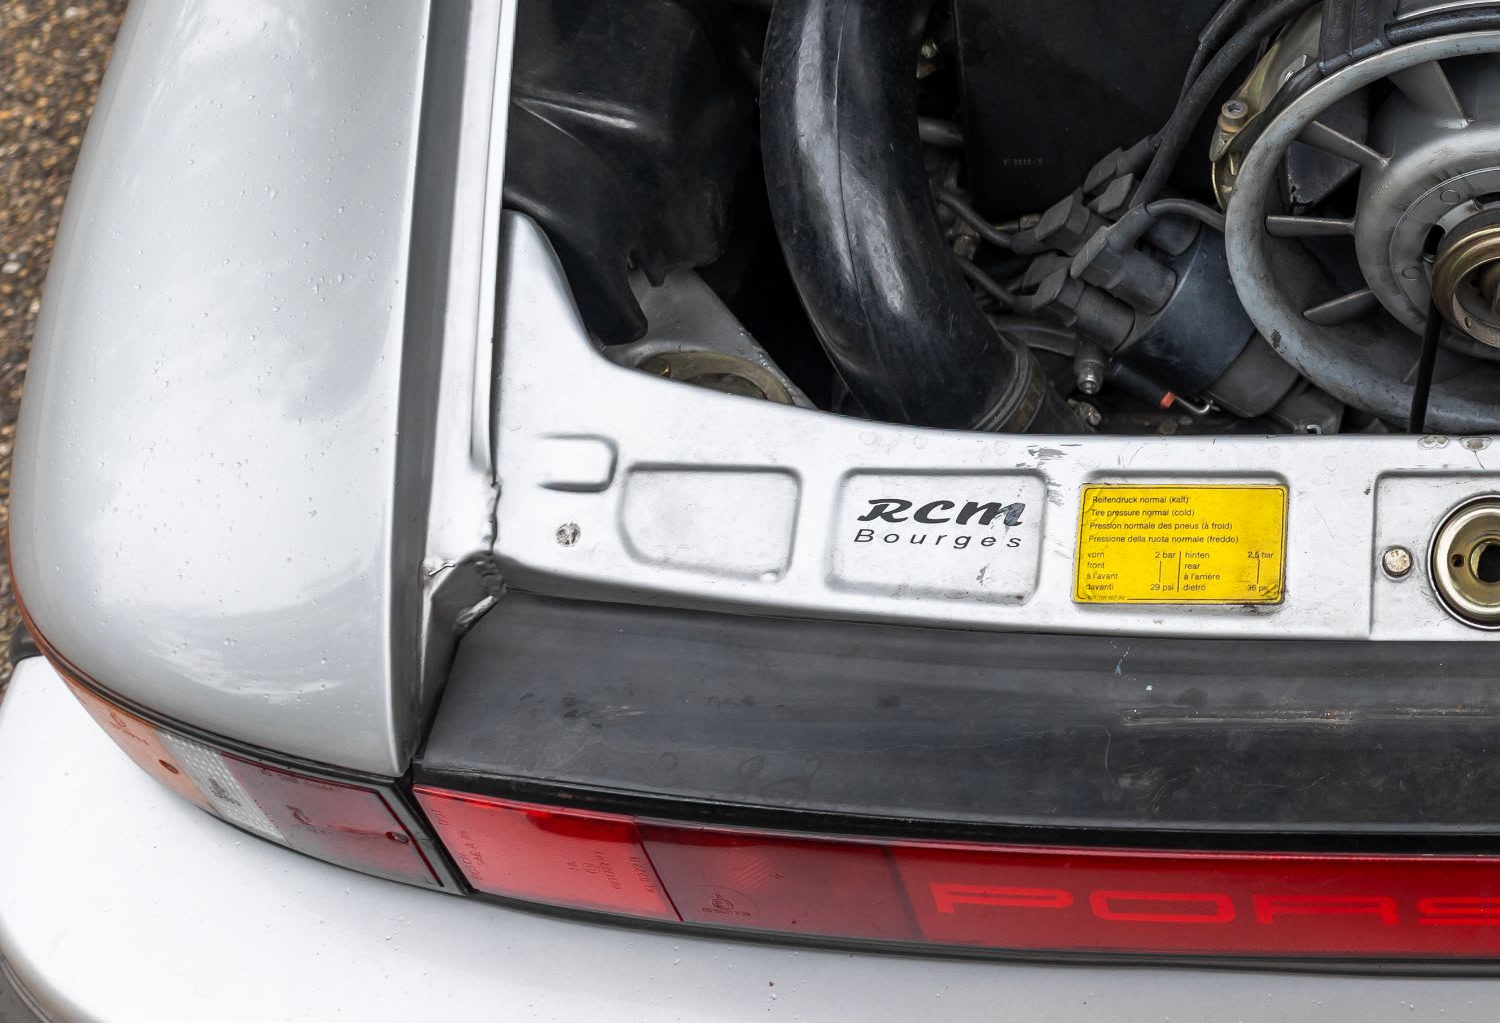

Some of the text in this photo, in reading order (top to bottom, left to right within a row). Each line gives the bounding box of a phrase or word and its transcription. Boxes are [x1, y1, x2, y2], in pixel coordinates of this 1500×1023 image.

[1172, 509, 1195, 517] (cold)
[1202, 522, 1209, 530] (à
[1212, 522, 1232, 530] froid)
[854, 529, 1022, 549] Bourges
[1207, 536, 1239, 544] (freddo)
[1163, 584, 1174, 592] psi
